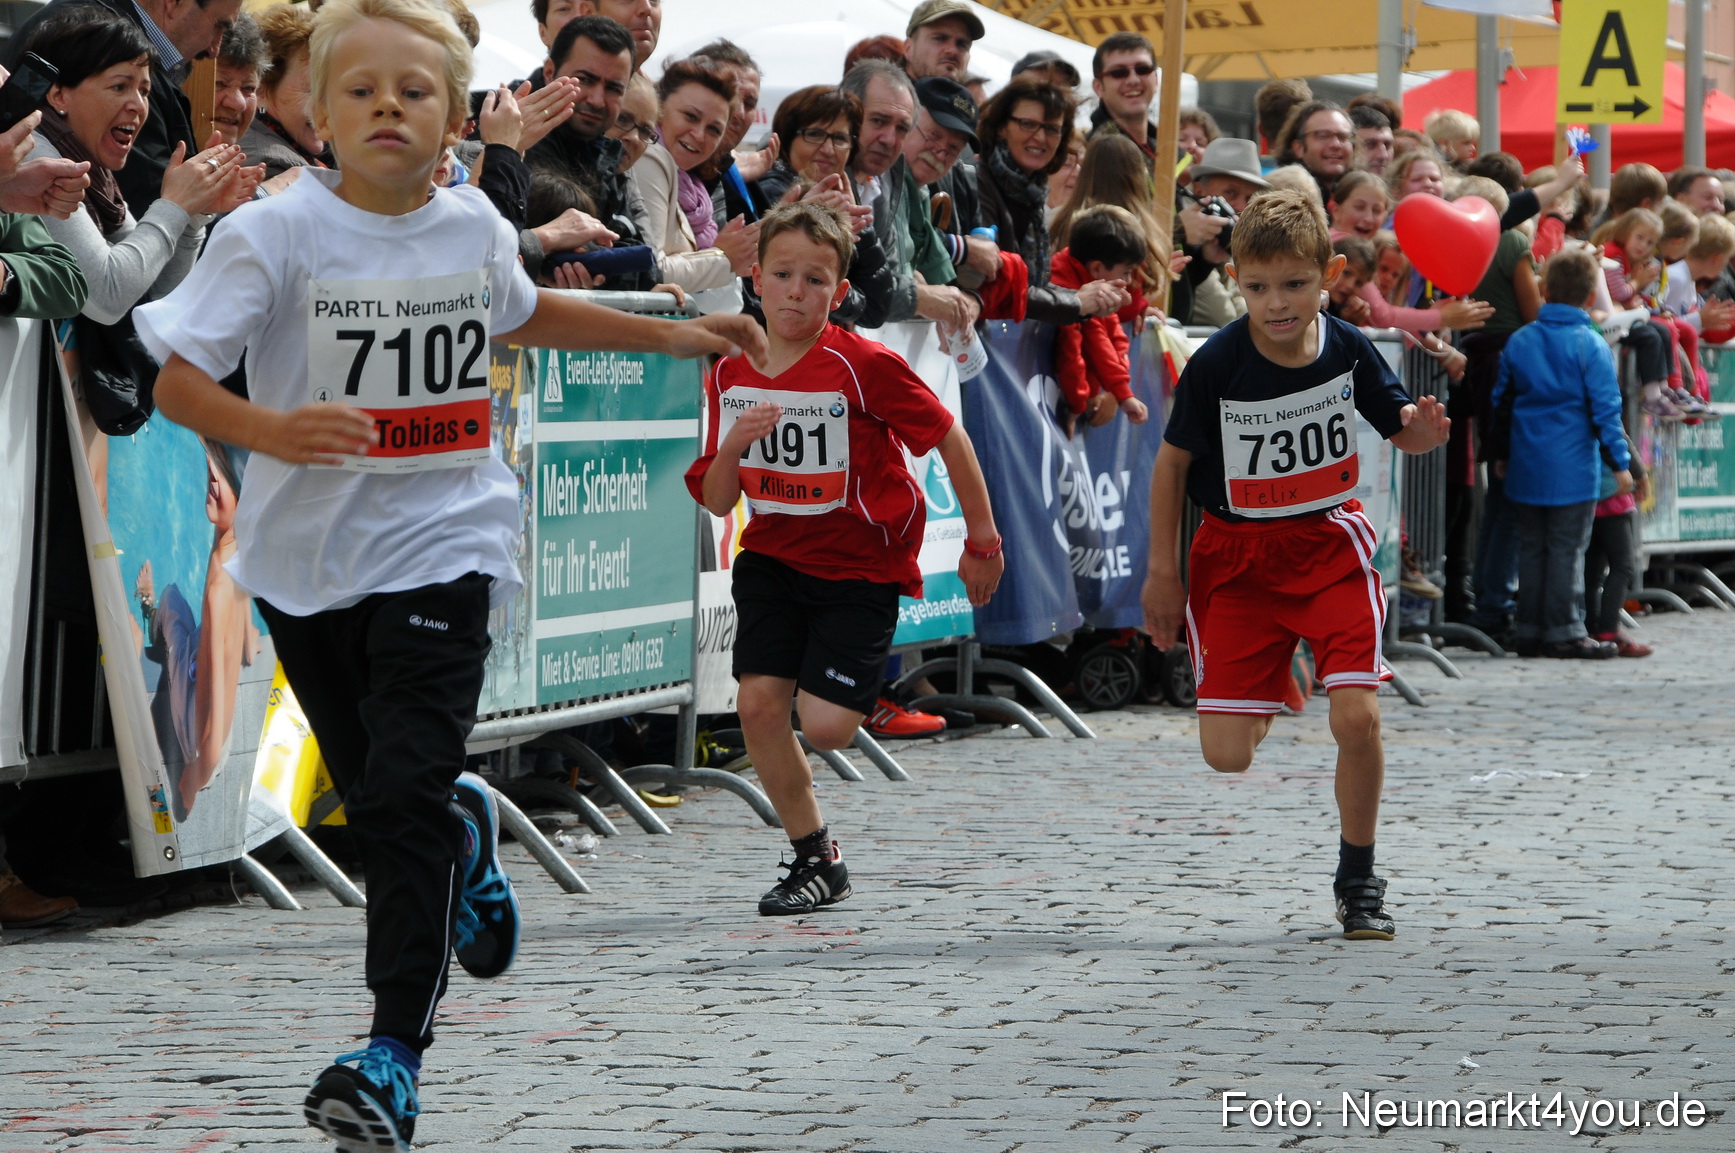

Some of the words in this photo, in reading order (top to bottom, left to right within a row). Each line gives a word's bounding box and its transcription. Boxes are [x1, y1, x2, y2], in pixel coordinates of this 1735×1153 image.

[1579, 9, 1641, 87] A
[315, 300, 390, 318] PARTL
[396, 293, 475, 318] Neumarkt
[336, 319, 487, 397] 7102
[490, 356, 511, 397] dgas
[566, 351, 644, 393] Event-Leit-Systeme
[318, 390, 327, 402] 4
[1225, 412, 1273, 425] PARTL
[1276, 394, 1338, 422] Neumarkt
[374, 416, 459, 449] Tobias
[738, 421, 827, 468] 091
[1239, 412, 1348, 476] 7306
[837, 460, 845, 469] M
[543, 459, 580, 517] Mehr
[583, 457, 648, 515] Sicherheit
[760, 475, 807, 499] Kilian
[1244, 483, 1298, 506] Felix
[542, 539, 563, 597] für
[567, 538, 585, 594] Ihr
[589, 537, 631, 592] Event!
[423, 618, 449, 630] JAKO
[541, 653, 562, 687] Miet
[563, 650, 570, 685] &
[572, 645, 600, 683] Service
[601, 643, 620, 678] Line:
[621, 640, 644, 674] 09181
[645, 636, 664, 670] 6352
